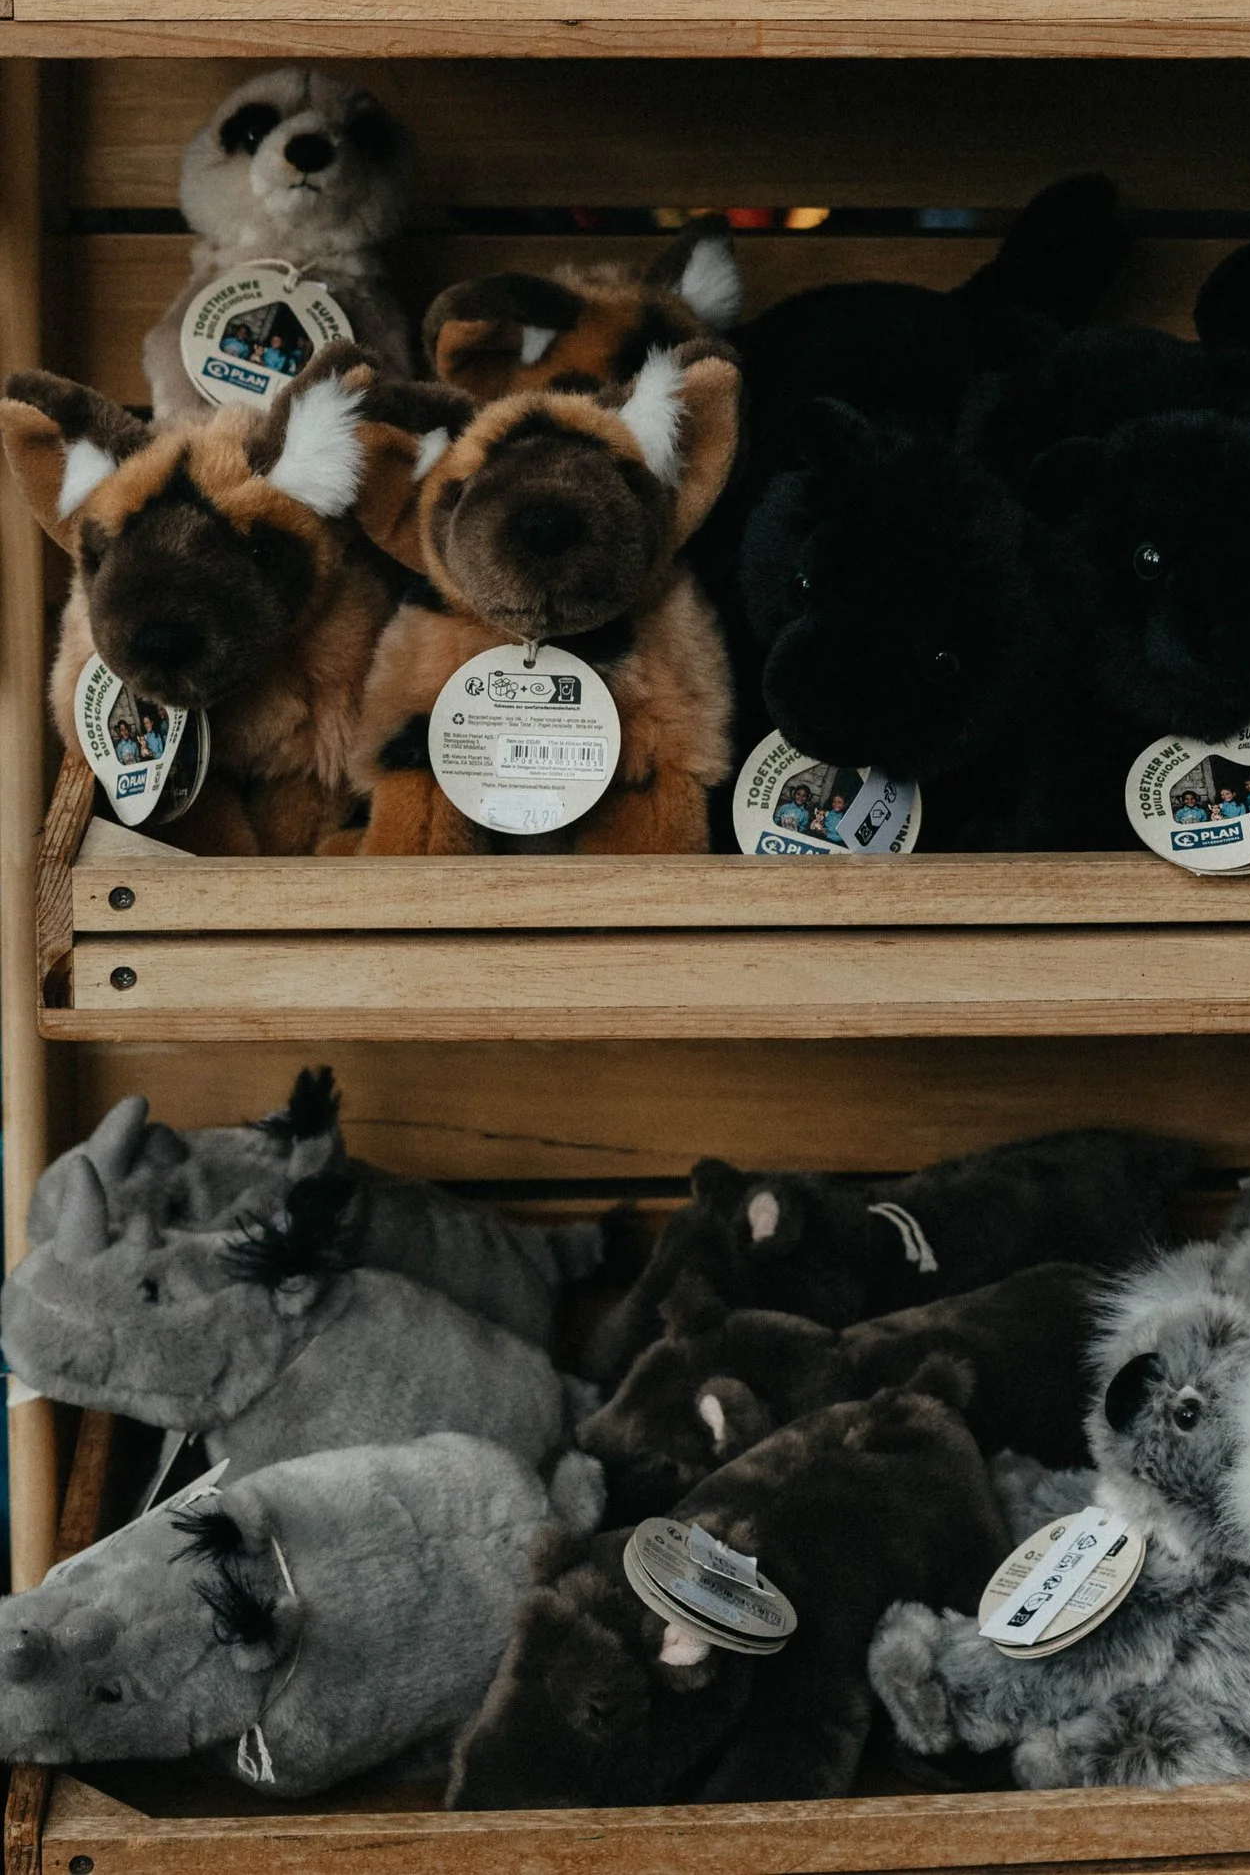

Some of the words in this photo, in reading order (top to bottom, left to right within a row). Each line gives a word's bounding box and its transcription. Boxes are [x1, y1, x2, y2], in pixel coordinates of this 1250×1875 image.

[194, 285, 236, 337] TOGETHER
[238, 279, 260, 291] WE
[231, 369, 267, 387] PLAN
[91, 664, 108, 685] WE
[94, 676, 114, 724] SCHOOLS
[84, 684, 103, 761] TOGETHER
[95, 724, 111, 757] BUILD
[130, 772, 146, 785] PLAN
[1139, 756, 1163, 820] TOGETHER
[1160, 741, 1184, 760] WE
[1156, 752, 1191, 788] SCHOOLS
[760, 777, 777, 810] BUILD
[1152, 789, 1166, 817] BUILD
[1200, 826, 1240, 841] PLAN
